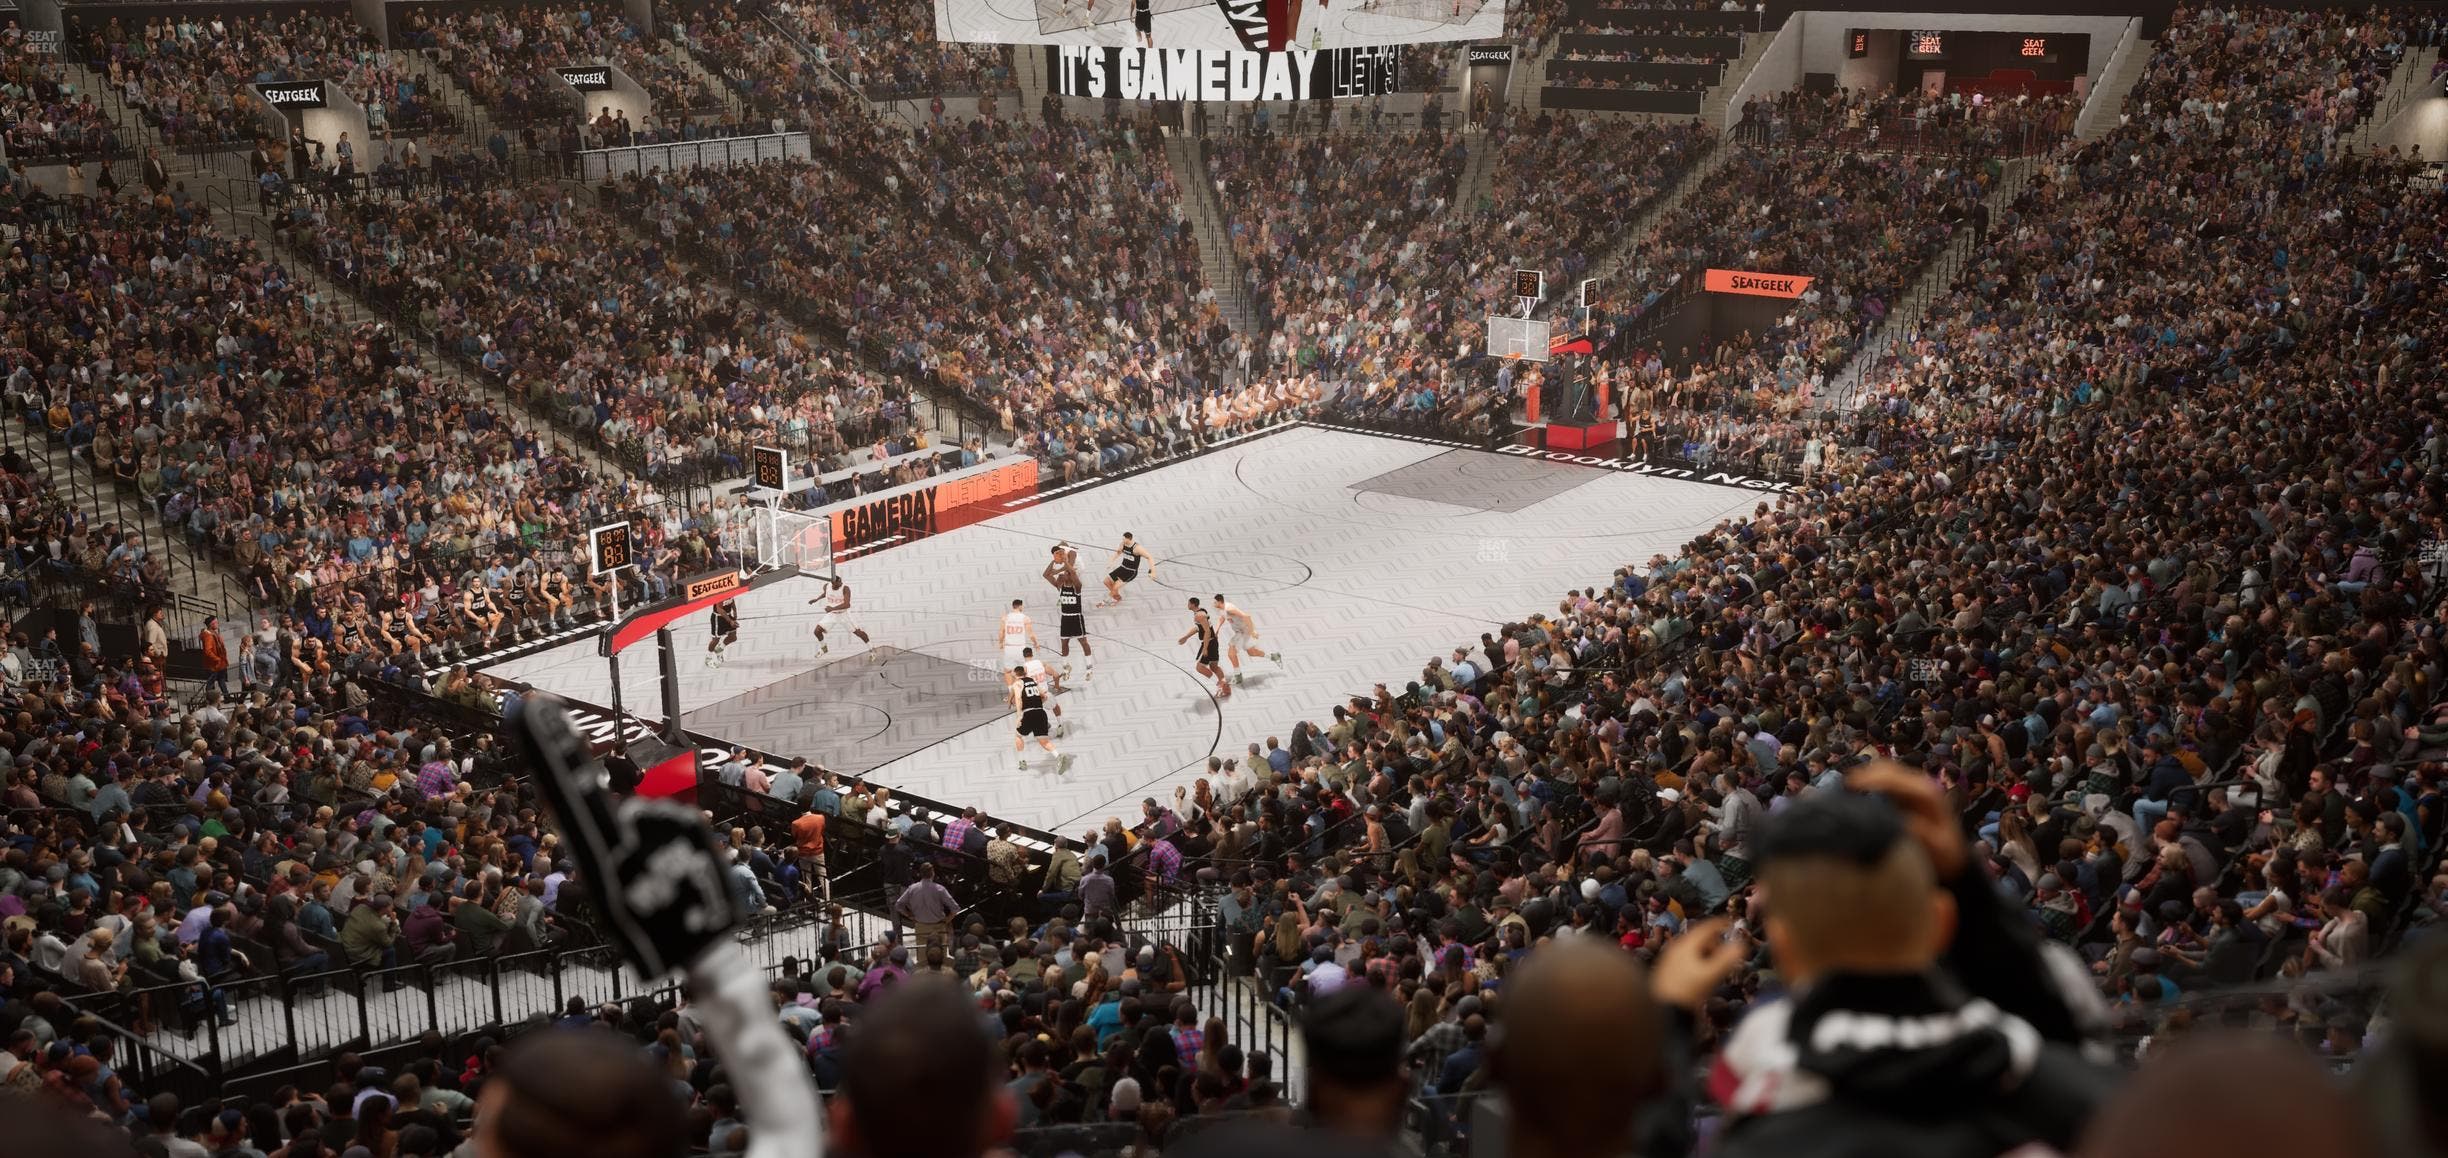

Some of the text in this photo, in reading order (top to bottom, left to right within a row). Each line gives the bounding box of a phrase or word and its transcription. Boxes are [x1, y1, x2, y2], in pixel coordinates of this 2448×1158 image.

[1920, 36, 1942, 45] SEAT
[2023, 38, 2046, 48] SEAT
[1470, 50, 1511, 60] SEATGEEK
[1919, 45, 1942, 54] GEEK
[2021, 47, 2045, 56] GEEK
[563, 71, 606, 86] SEATGEEK
[1059, 44, 1106, 97] IT'S
[1119, 46, 1318, 101] GAMEDAY
[1331, 43, 1395, 99] LET'S
[265, 86, 321, 104] SEATGEEK
[1731, 275, 1794, 294] SEATGEEK
[842, 484, 938, 538] GAMEDAY
[946, 468, 1001, 510] LET'S
[691, 574, 734, 597] SEATGEEK
